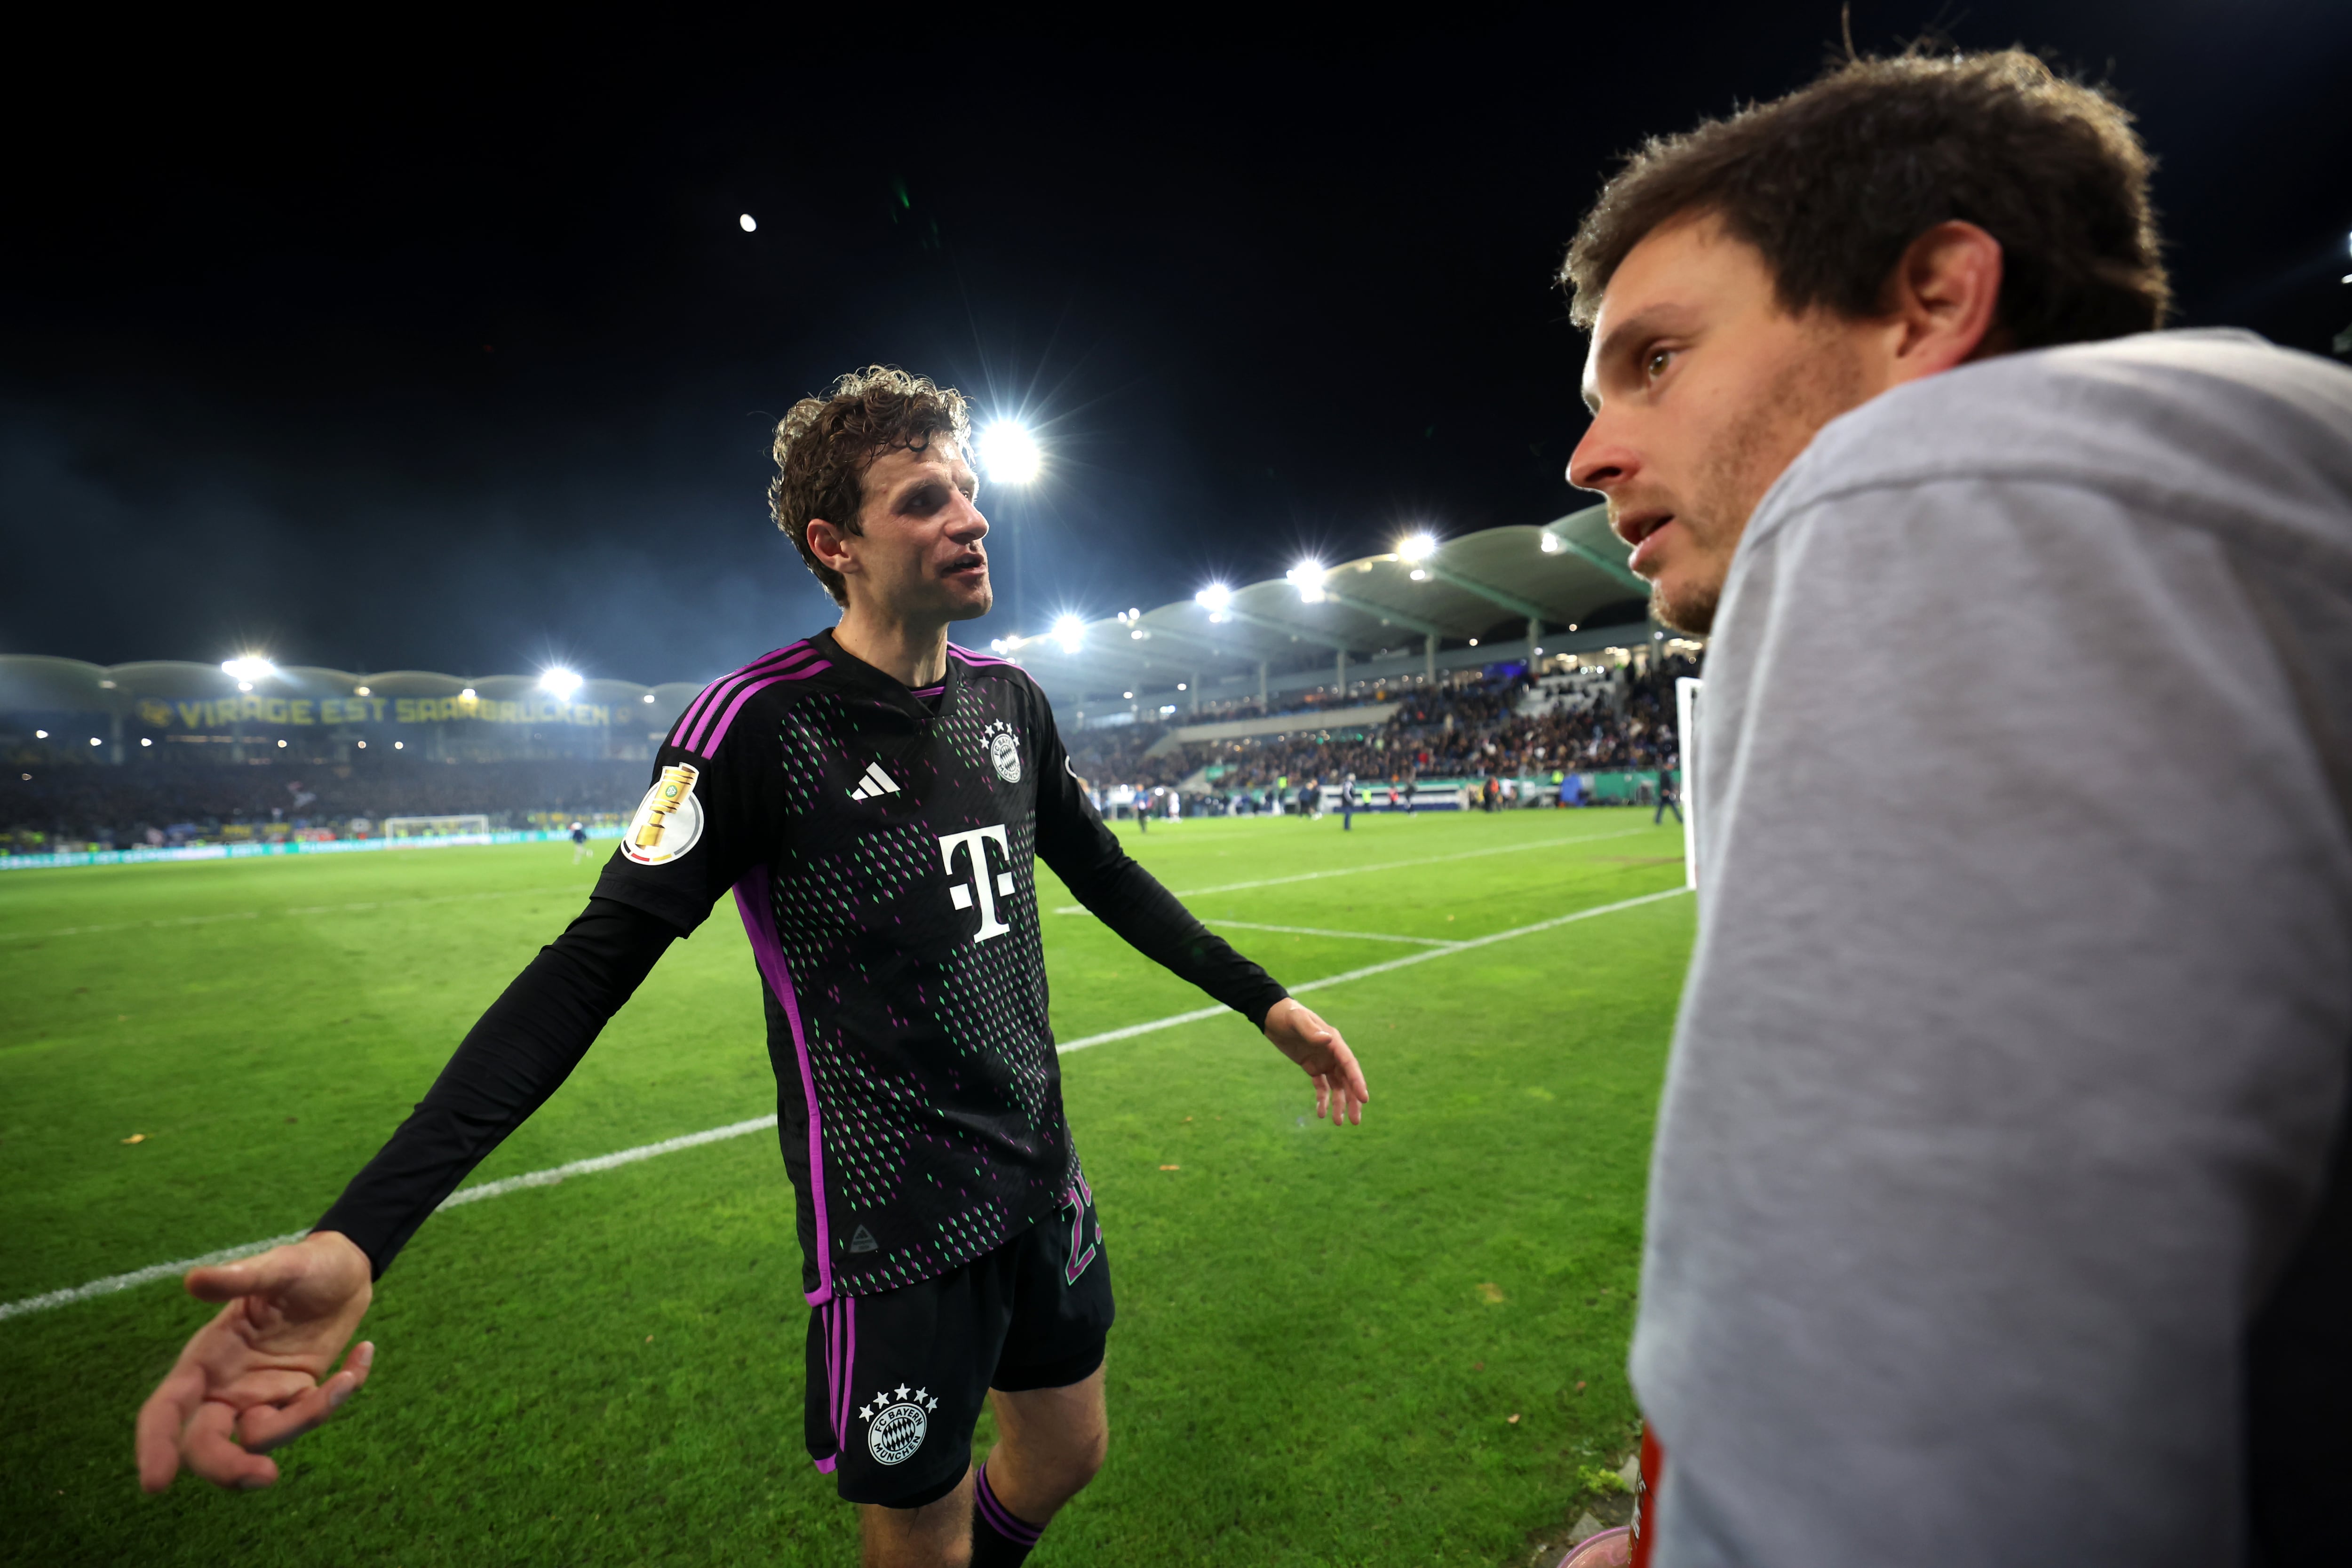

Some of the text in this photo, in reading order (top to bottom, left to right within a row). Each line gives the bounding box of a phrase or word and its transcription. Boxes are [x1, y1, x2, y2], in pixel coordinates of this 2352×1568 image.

[176, 695, 315, 729] VIRAGE
[321, 698, 387, 725] EST
[938, 824, 1011, 943] T
[875, 1408, 923, 1432] FC BAYERN
[874, 1436, 921, 1461] MÜNCHEN
